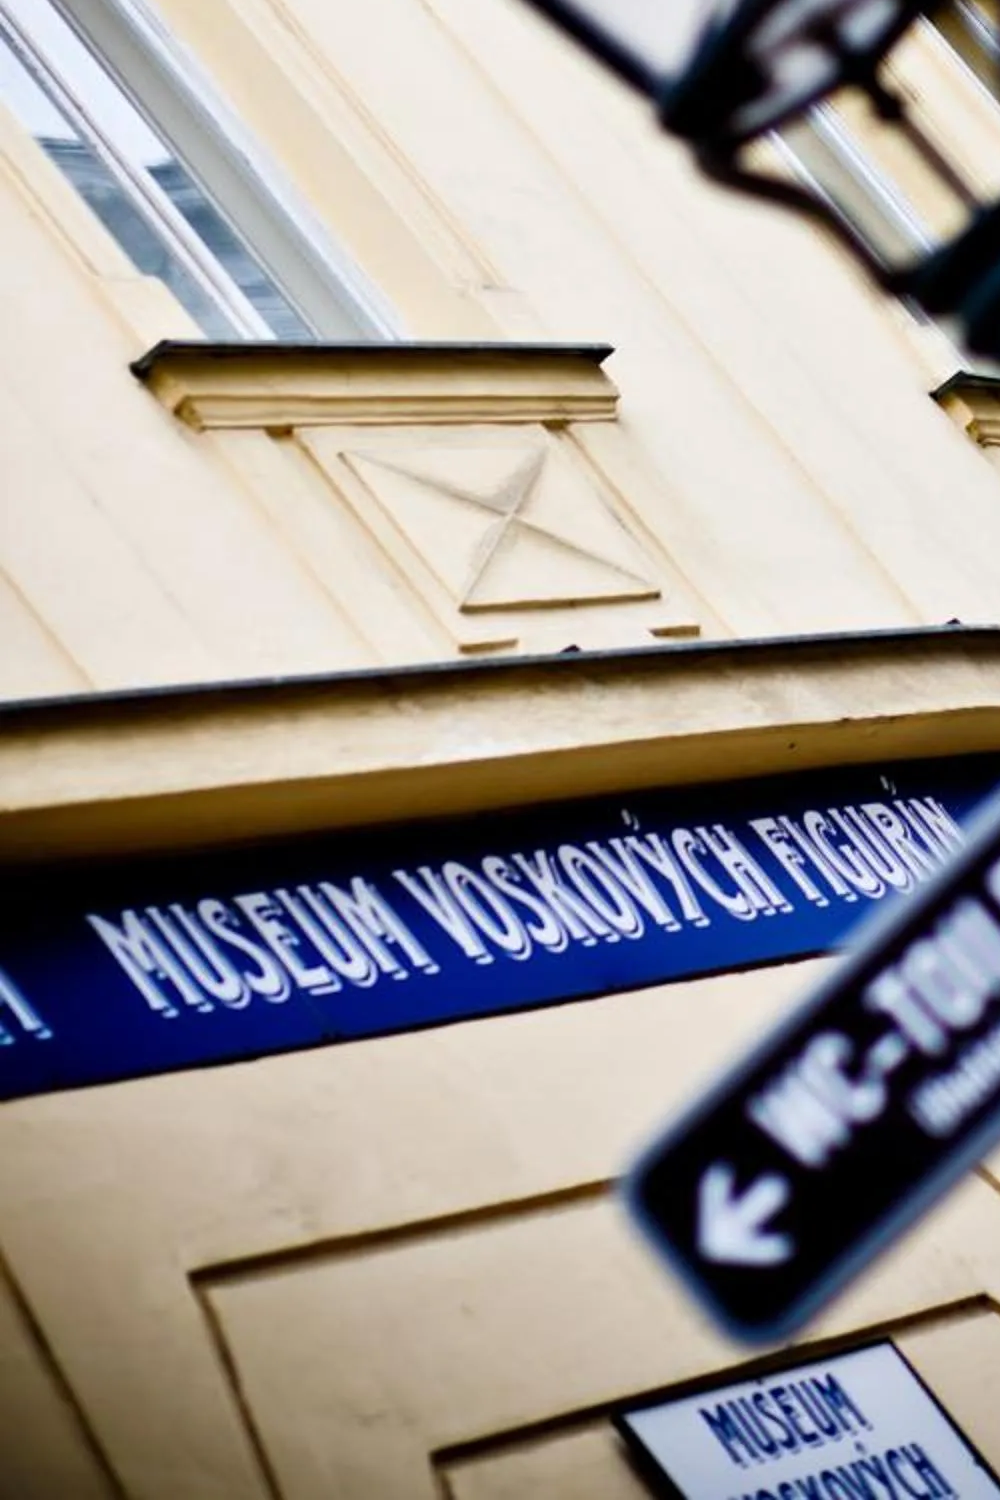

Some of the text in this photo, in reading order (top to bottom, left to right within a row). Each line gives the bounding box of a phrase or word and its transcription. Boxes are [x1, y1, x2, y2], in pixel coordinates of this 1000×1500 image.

[86, 875, 440, 1018] MUSEUM
[393, 809, 793, 965] VOSKOVÝCH
[698, 1373, 873, 1468] MUSEUM
